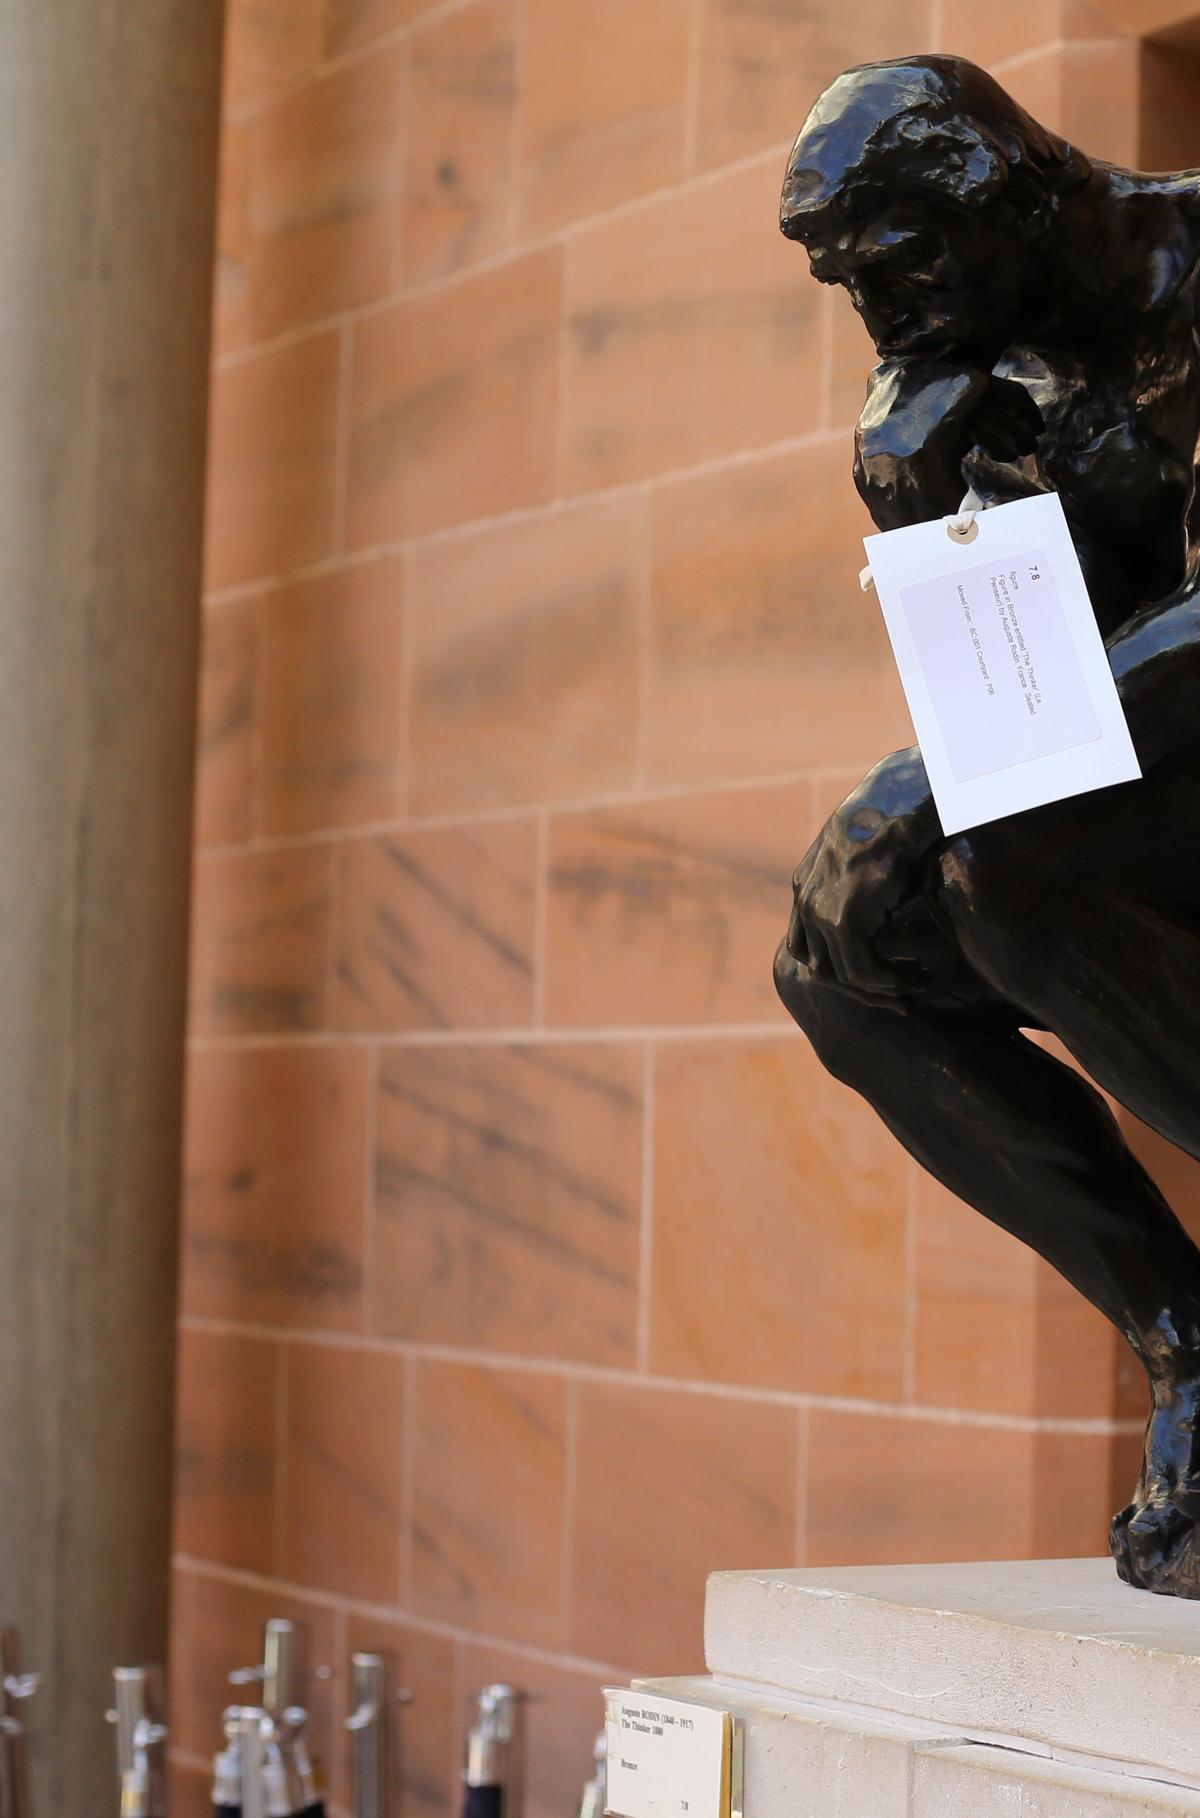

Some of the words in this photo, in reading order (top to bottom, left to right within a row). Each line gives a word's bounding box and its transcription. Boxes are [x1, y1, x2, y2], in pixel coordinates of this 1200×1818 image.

[1009, 571, 1019, 590] figure
[1028, 565, 1040, 581] 7.8
[990, 576, 1003, 606] Penseur)
[998, 607, 1005, 616] by
[957, 584, 967, 606] Moved
[976, 650, 990, 680] Courtyard
[998, 574, 1009, 595] Figure
[1007, 603, 1018, 627] Bronze
[1015, 628, 1026, 651] entitled
[1032, 692, 1042, 704] (Le
[1000, 617, 1014, 644] Auguste
[1024, 692, 1036, 715] Seated
[641, 1709, 660, 1722] RODIN
[621, 1719, 631, 1729] The
[631, 1721, 651, 1734] Thinker
